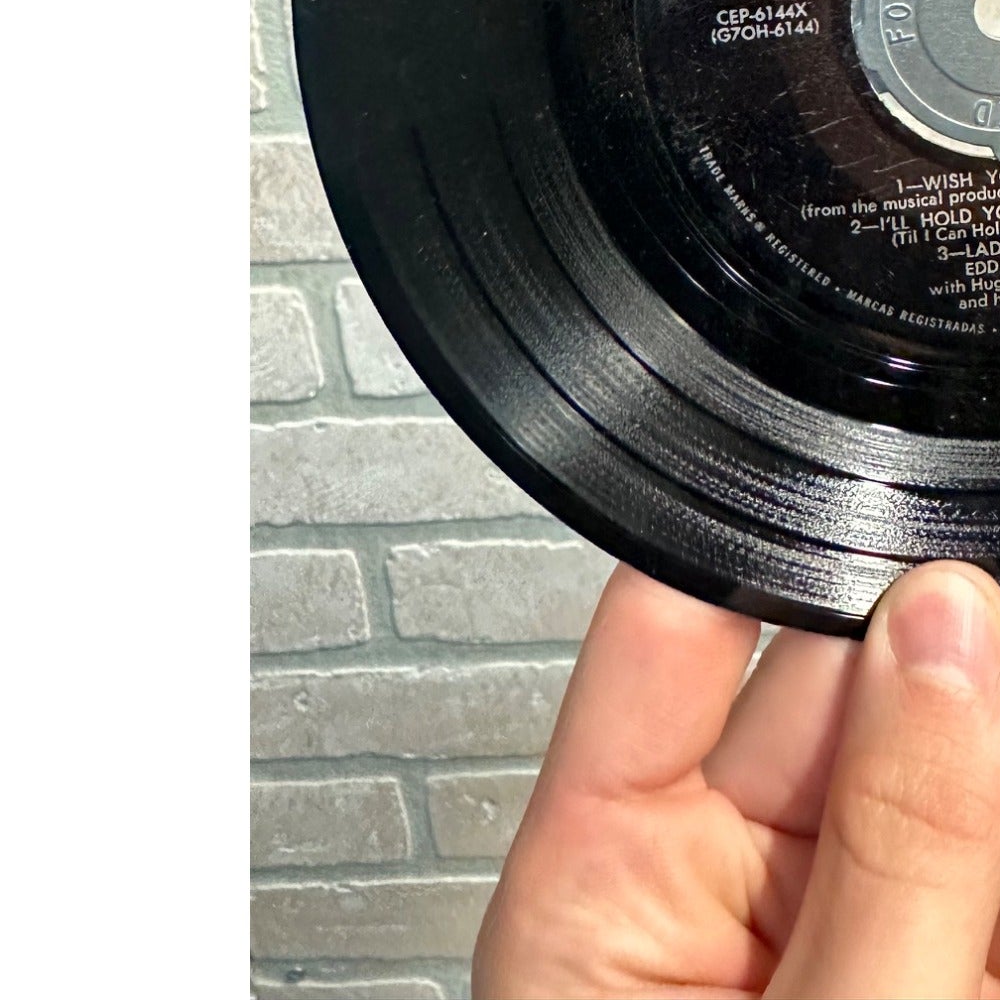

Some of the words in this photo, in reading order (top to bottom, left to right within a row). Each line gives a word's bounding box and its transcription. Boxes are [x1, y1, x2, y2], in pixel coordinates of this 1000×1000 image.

[715, 1, 808, 26] CEP-6144X
[800, 203, 846, 221] (from
[852, 199, 878, 214] the
[883, 190, 943, 211] musical
[920, 207, 972, 229] HOLD
[935, 227, 967, 242] Can
[764, 232, 831, 287] REGISTERED
[899, 309, 985, 335] REGISTRADAS
[928, 278, 966, 297] with
[958, 295, 988, 310] and
